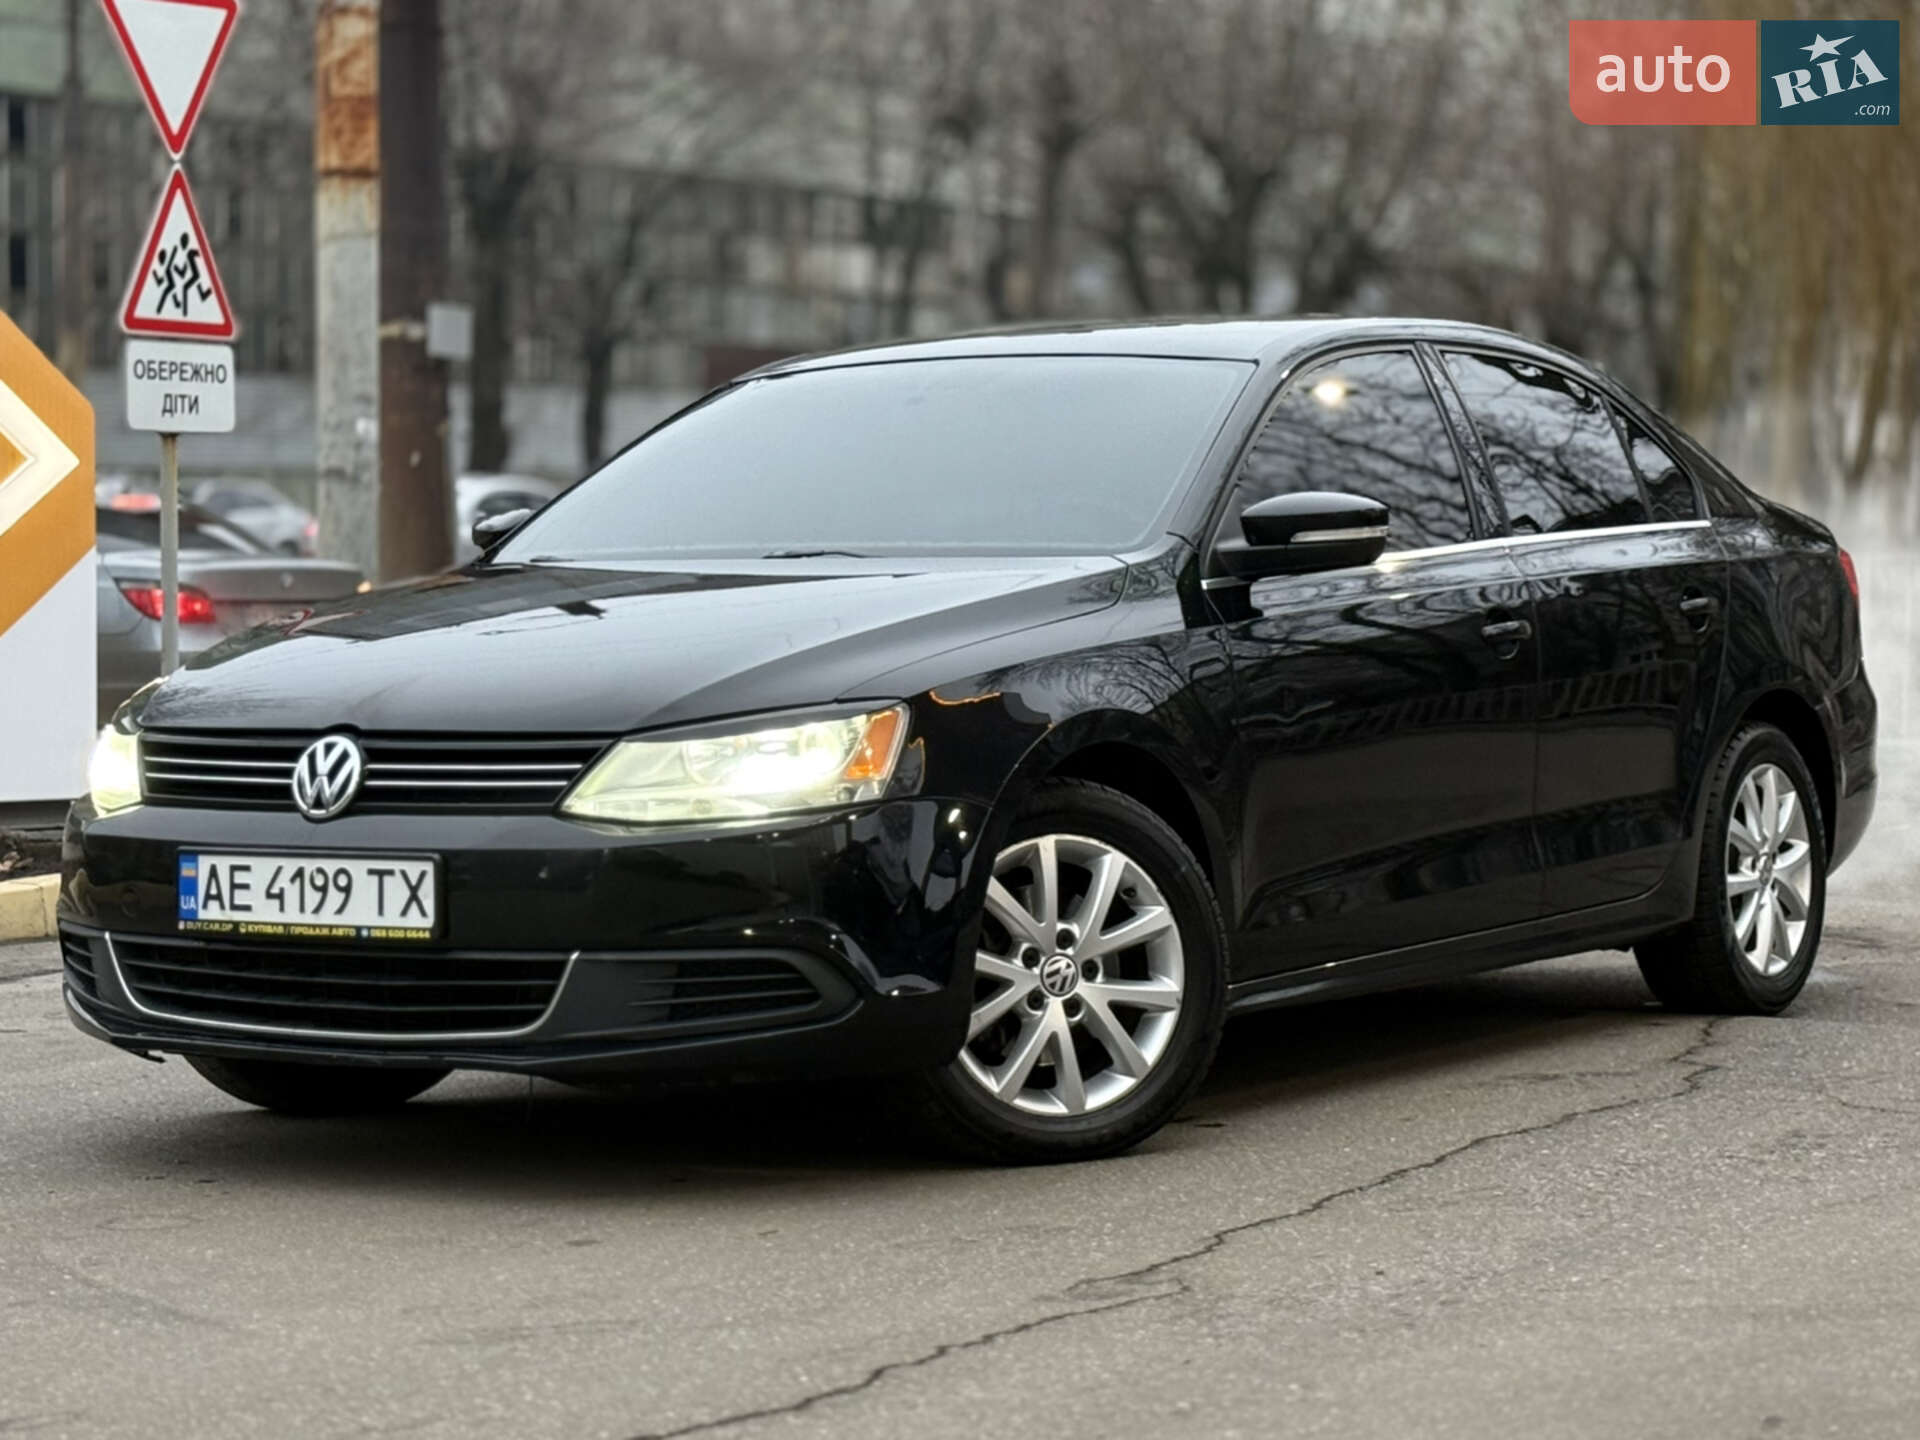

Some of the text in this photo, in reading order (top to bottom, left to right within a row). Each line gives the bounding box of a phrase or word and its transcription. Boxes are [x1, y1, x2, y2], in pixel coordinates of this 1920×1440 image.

[133, 358, 228, 384] ОБЕРЕЖНО
[161, 393, 200, 418] ДІТИ
[180, 895, 197, 910] UA
[201, 863, 429, 919] AE 4199 TX
[331, 927, 357, 937] АВТО
